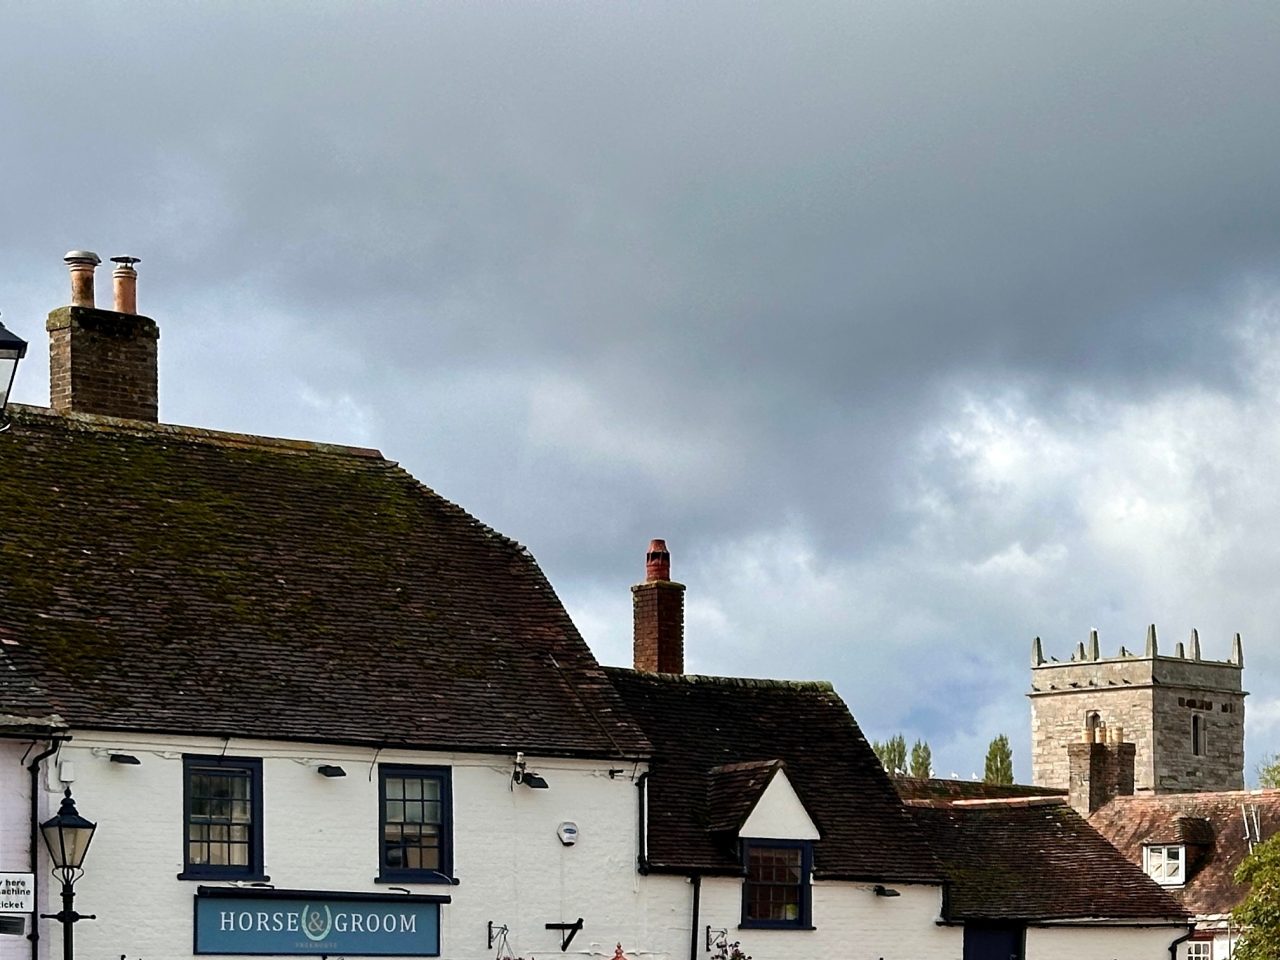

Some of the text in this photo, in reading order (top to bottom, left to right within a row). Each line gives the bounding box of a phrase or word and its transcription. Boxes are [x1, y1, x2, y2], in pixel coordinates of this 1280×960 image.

[0, 901, 24, 909] icket
[220, 911, 416, 933] HORSE & GROOM
